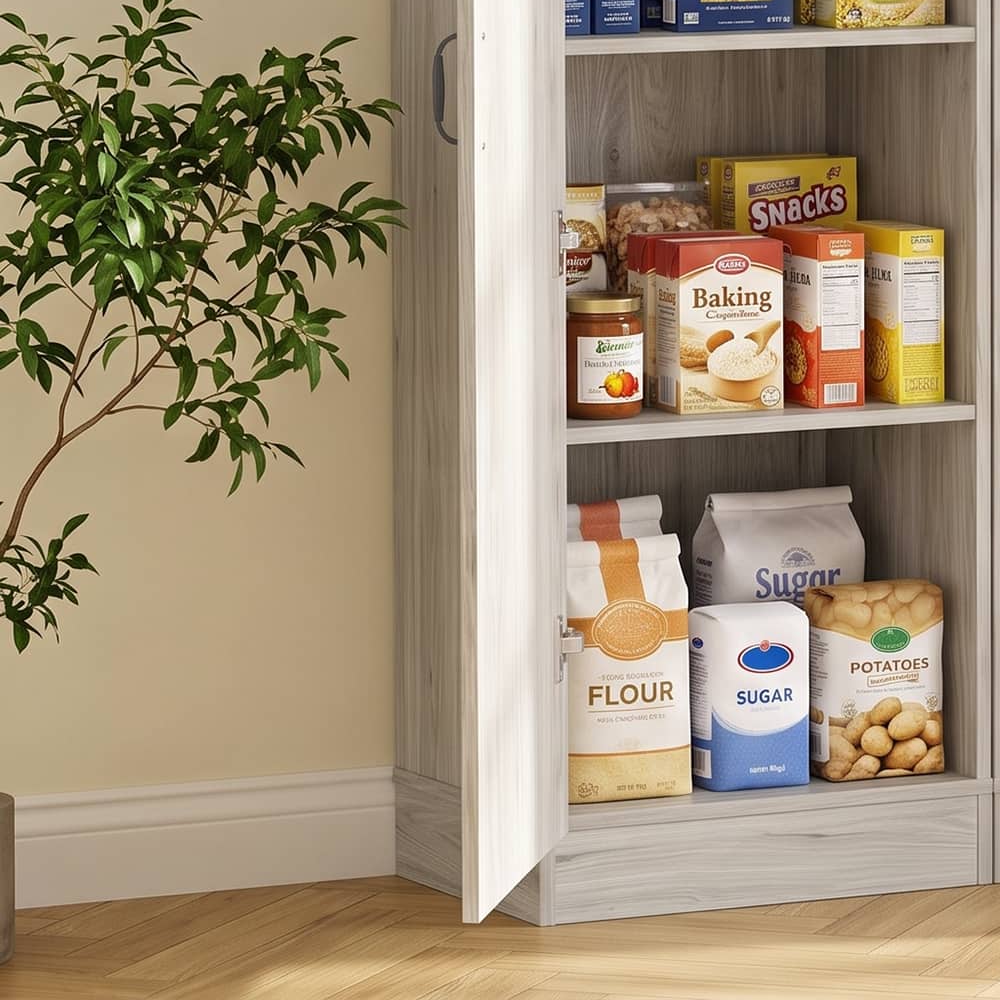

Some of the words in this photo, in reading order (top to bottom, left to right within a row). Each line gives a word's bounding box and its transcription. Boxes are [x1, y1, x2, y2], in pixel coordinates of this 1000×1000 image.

[750, 186, 846, 232] Snacks
[692, 286, 772, 312] Baking
[755, 567, 842, 603] Sugar
[850, 657, 930, 675] POTATOES
[587, 681, 675, 707] FLOUR
[736, 687, 794, 706] SUGAR
